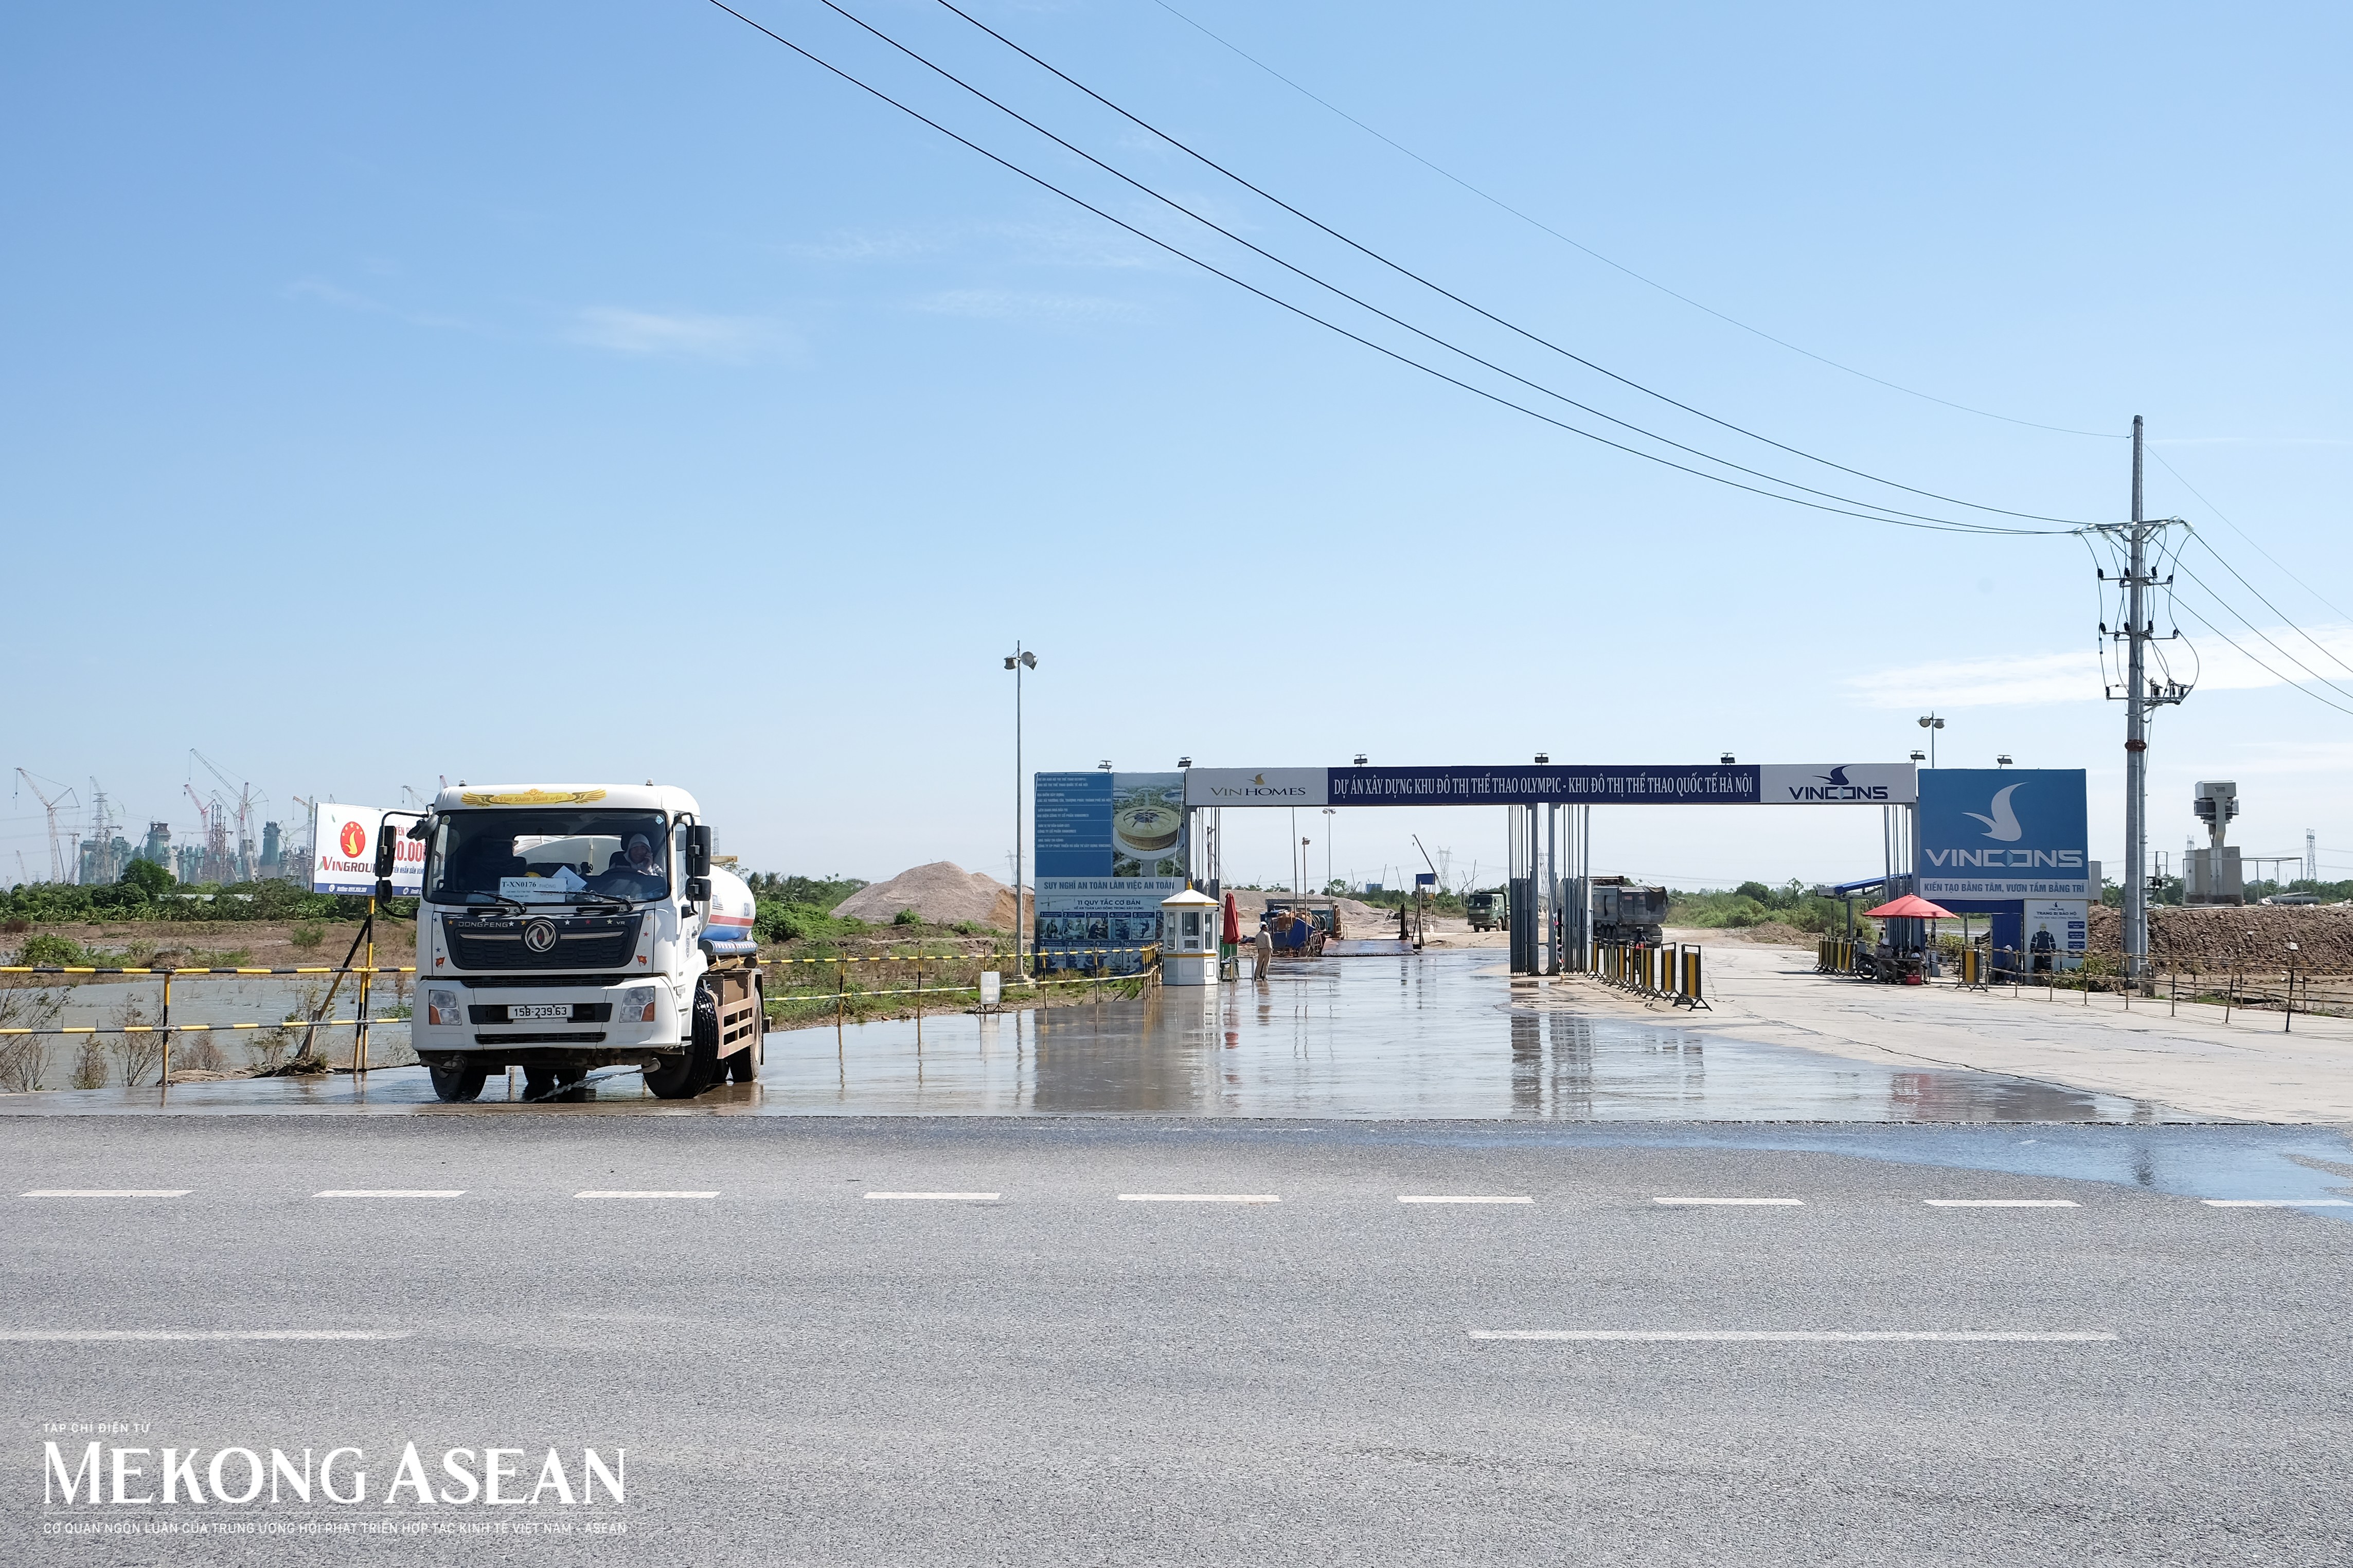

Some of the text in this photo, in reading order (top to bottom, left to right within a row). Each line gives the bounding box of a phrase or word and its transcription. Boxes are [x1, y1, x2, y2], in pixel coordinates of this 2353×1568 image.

[1333, 778, 1349, 799] DỰ
[1350, 774, 1364, 795] ÁN
[1365, 774, 1384, 795] XÂY
[1385, 778, 1413, 799] DỰNG
[1414, 778, 1435, 794] KHU
[1436, 773, 1451, 794] ĐÔ
[1452, 778, 1469, 798] THỊ
[1471, 772, 1490, 794] THỂ
[1492, 777, 1519, 794] THAO
[1520, 777, 1561, 794] OLYMPIC
[1568, 777, 1589, 793] KHU
[1591, 772, 1605, 793] ĐÔ
[1607, 777, 1624, 798] THỊ
[1626, 771, 1646, 793] THỂ
[1647, 777, 1674, 793] THAO
[1676, 771, 1703, 797] QUỐC
[1704, 771, 1718, 793] TẾ
[1719, 772, 1734, 793] HÀ
[1735, 772, 1753, 797] NỘI
[1788, 786, 1888, 800] VINCONS
[322, 856, 376, 873] VINGROU
[1924, 849, 2083, 868] VINCONS
[1044, 880, 1174, 891] SUY NGHĨ AN TOÀN LÀM VIỆC AN TOÀN
[1924, 881, 1942, 891] KIẾN
[1944, 883, 1959, 893] TẠO
[1961, 881, 1983, 892] BẰNG
[1985, 882, 2004, 893] TÂM,
[2006, 883, 2028, 892] VƯƠN
[2048, 881, 2071, 893] BẰNG
[2072, 882, 2084, 893] TRÍ
